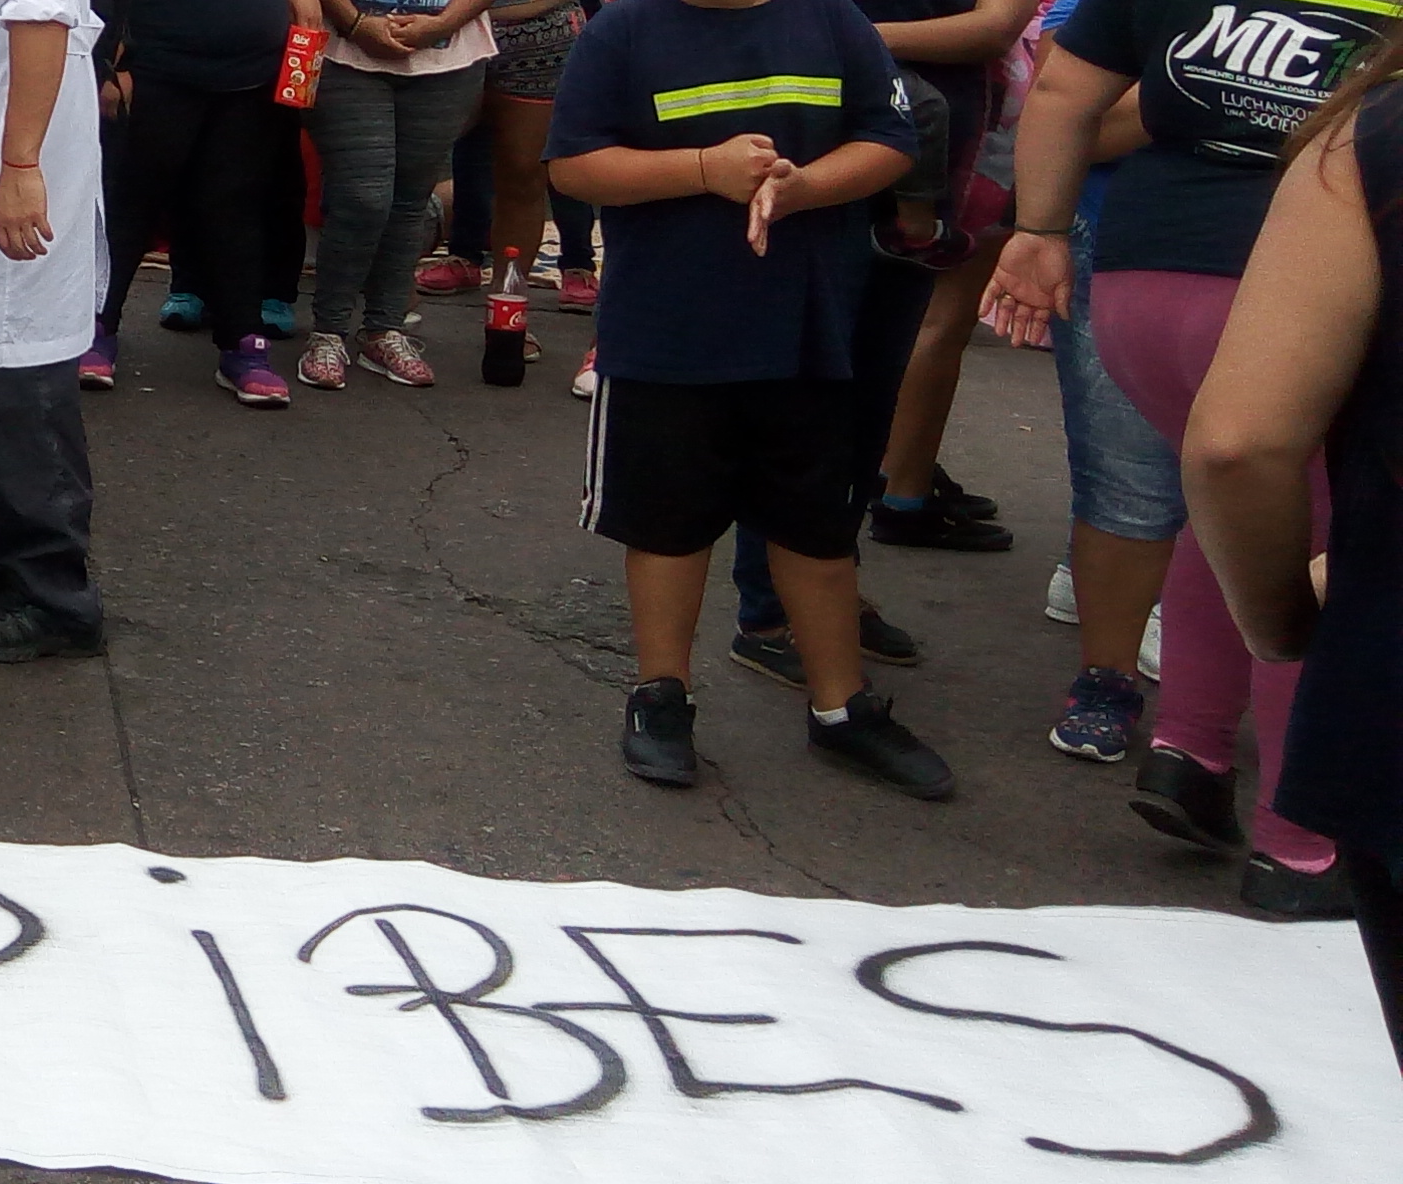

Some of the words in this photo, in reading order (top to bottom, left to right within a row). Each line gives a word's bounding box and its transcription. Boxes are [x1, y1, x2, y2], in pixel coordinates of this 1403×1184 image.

[1173, 4, 1342, 86] MTE
[1235, 74, 1246, 84] DE
[1221, 91, 1307, 122] LUCHANDO
[1250, 110, 1300, 133] SOCIED
